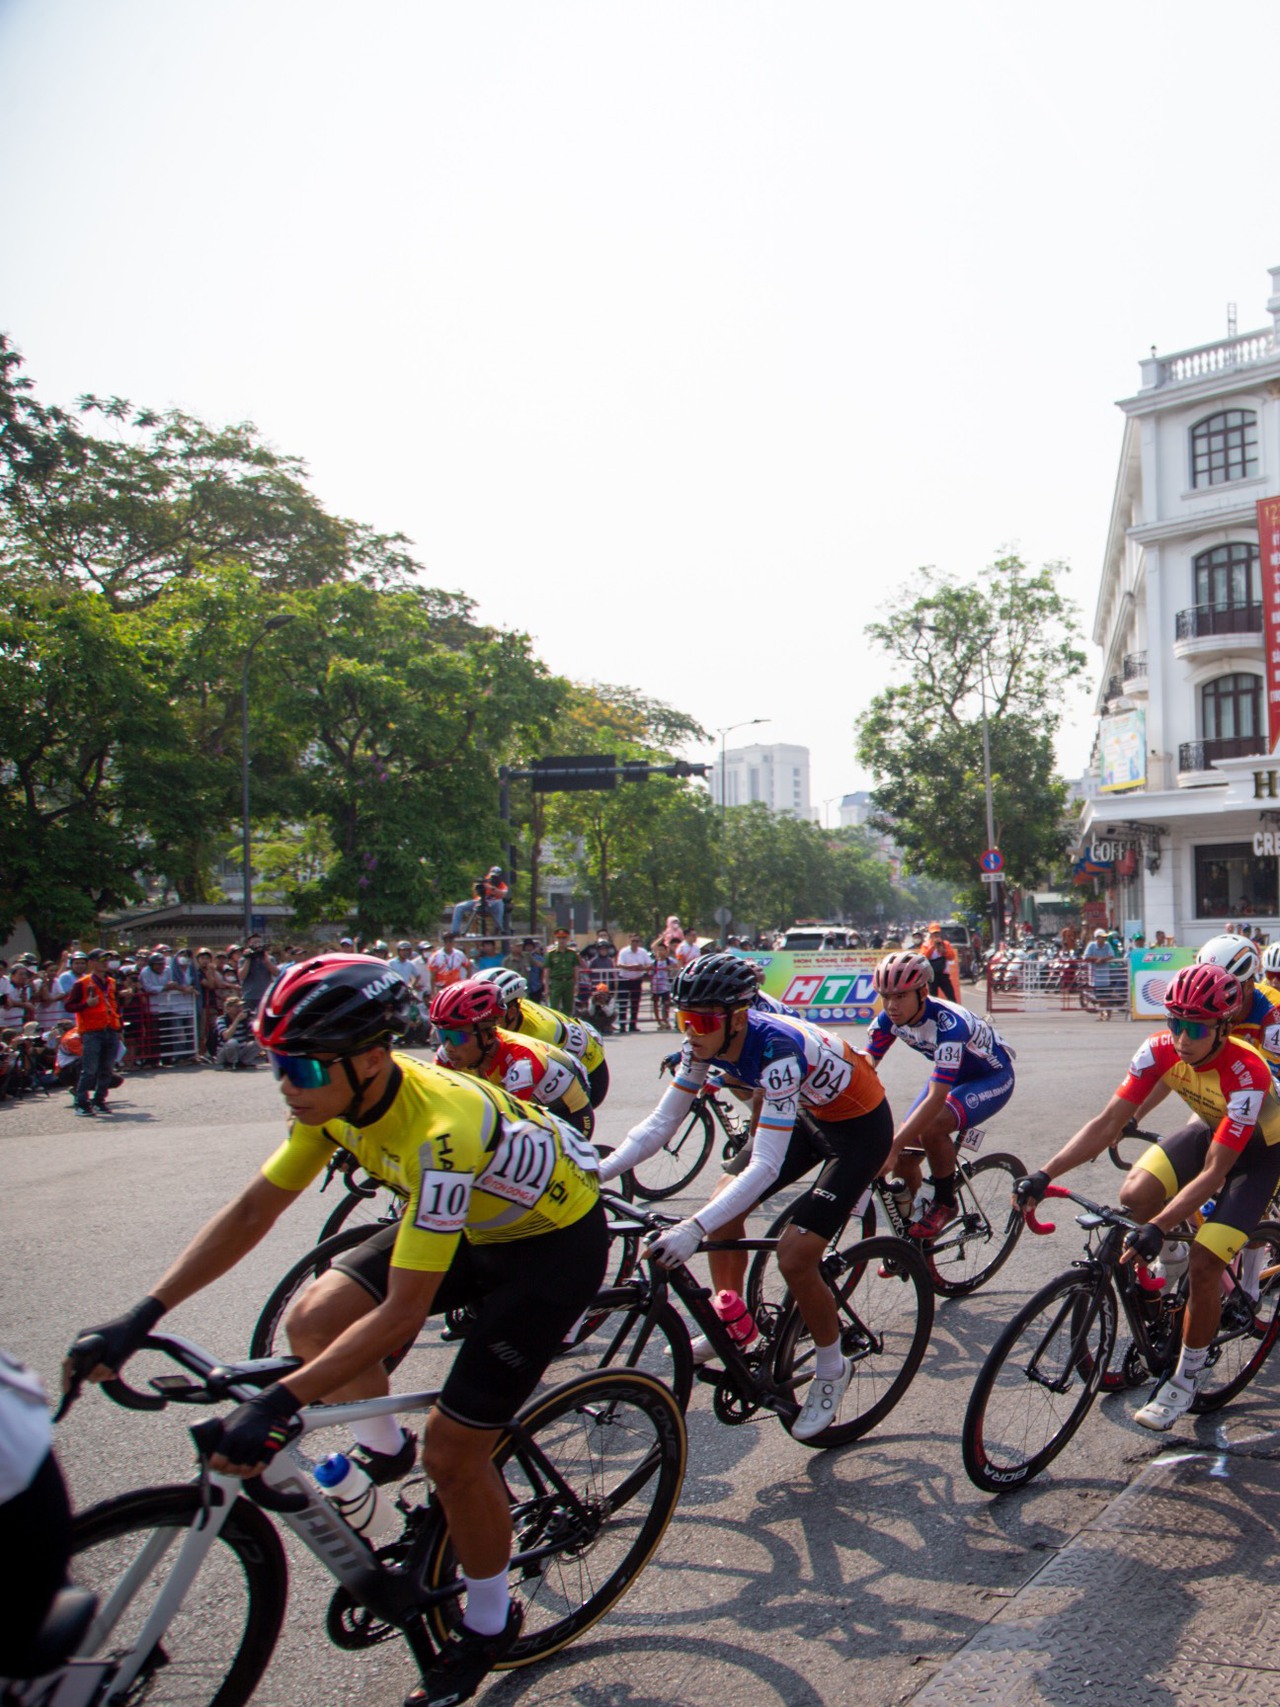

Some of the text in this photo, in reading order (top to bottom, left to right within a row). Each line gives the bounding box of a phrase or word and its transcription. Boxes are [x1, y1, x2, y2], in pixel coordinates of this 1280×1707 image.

[1143, 953, 1172, 962] HTV
[783, 977, 878, 1003] HTV
[472, 1009, 493, 1022] RUDY
[937, 1047, 960, 1062] 134
[510, 1067, 519, 1082] 5
[544, 1069, 564, 1093] 5
[768, 1064, 793, 1091] 64
[812, 1059, 846, 1099] 64
[1240, 1097, 1250, 1116] 4
[494, 1130, 547, 1190] 101
[428, 1182, 470, 1216] 10
[983, 1464, 1030, 1483] BORA
